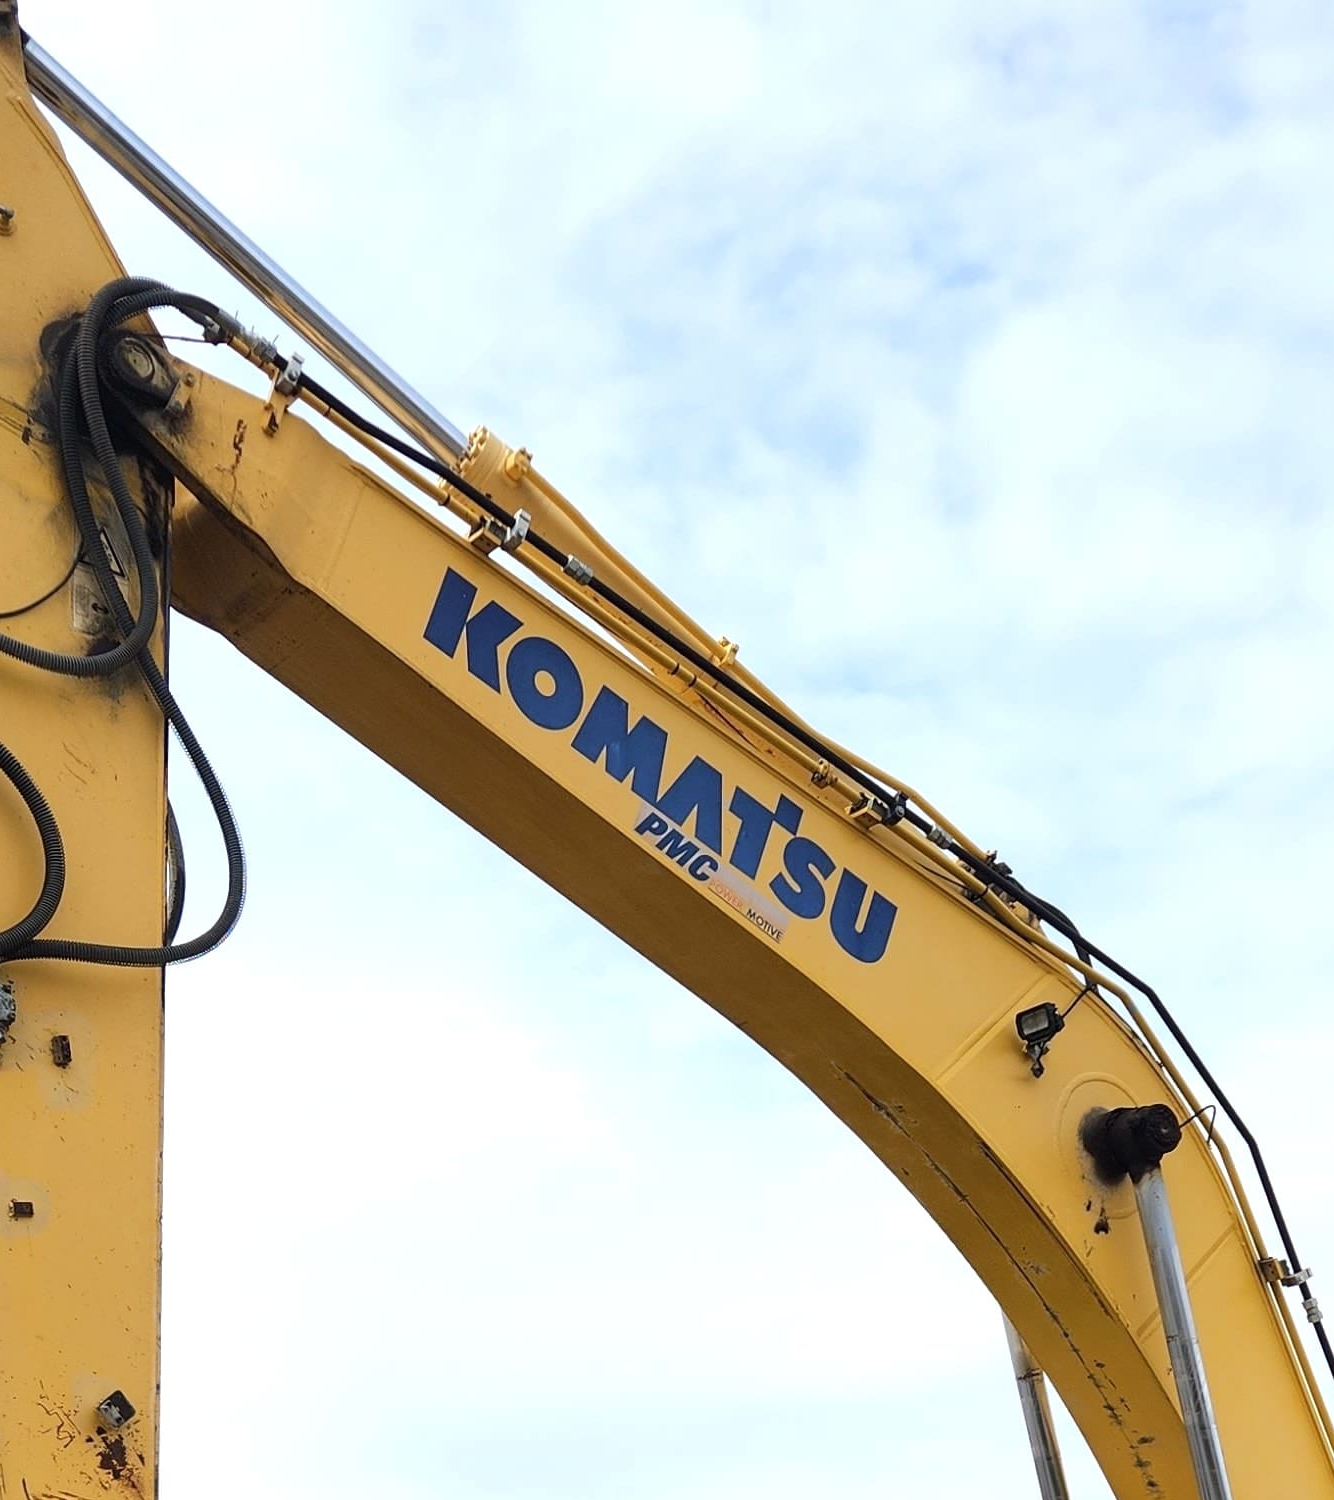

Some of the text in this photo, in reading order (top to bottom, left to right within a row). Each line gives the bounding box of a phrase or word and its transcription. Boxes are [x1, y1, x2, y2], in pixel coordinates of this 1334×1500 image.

[423, 567, 898, 963] KOMATSU
[634, 812, 719, 881] PMC
[747, 908, 784, 940] MOTIVE
